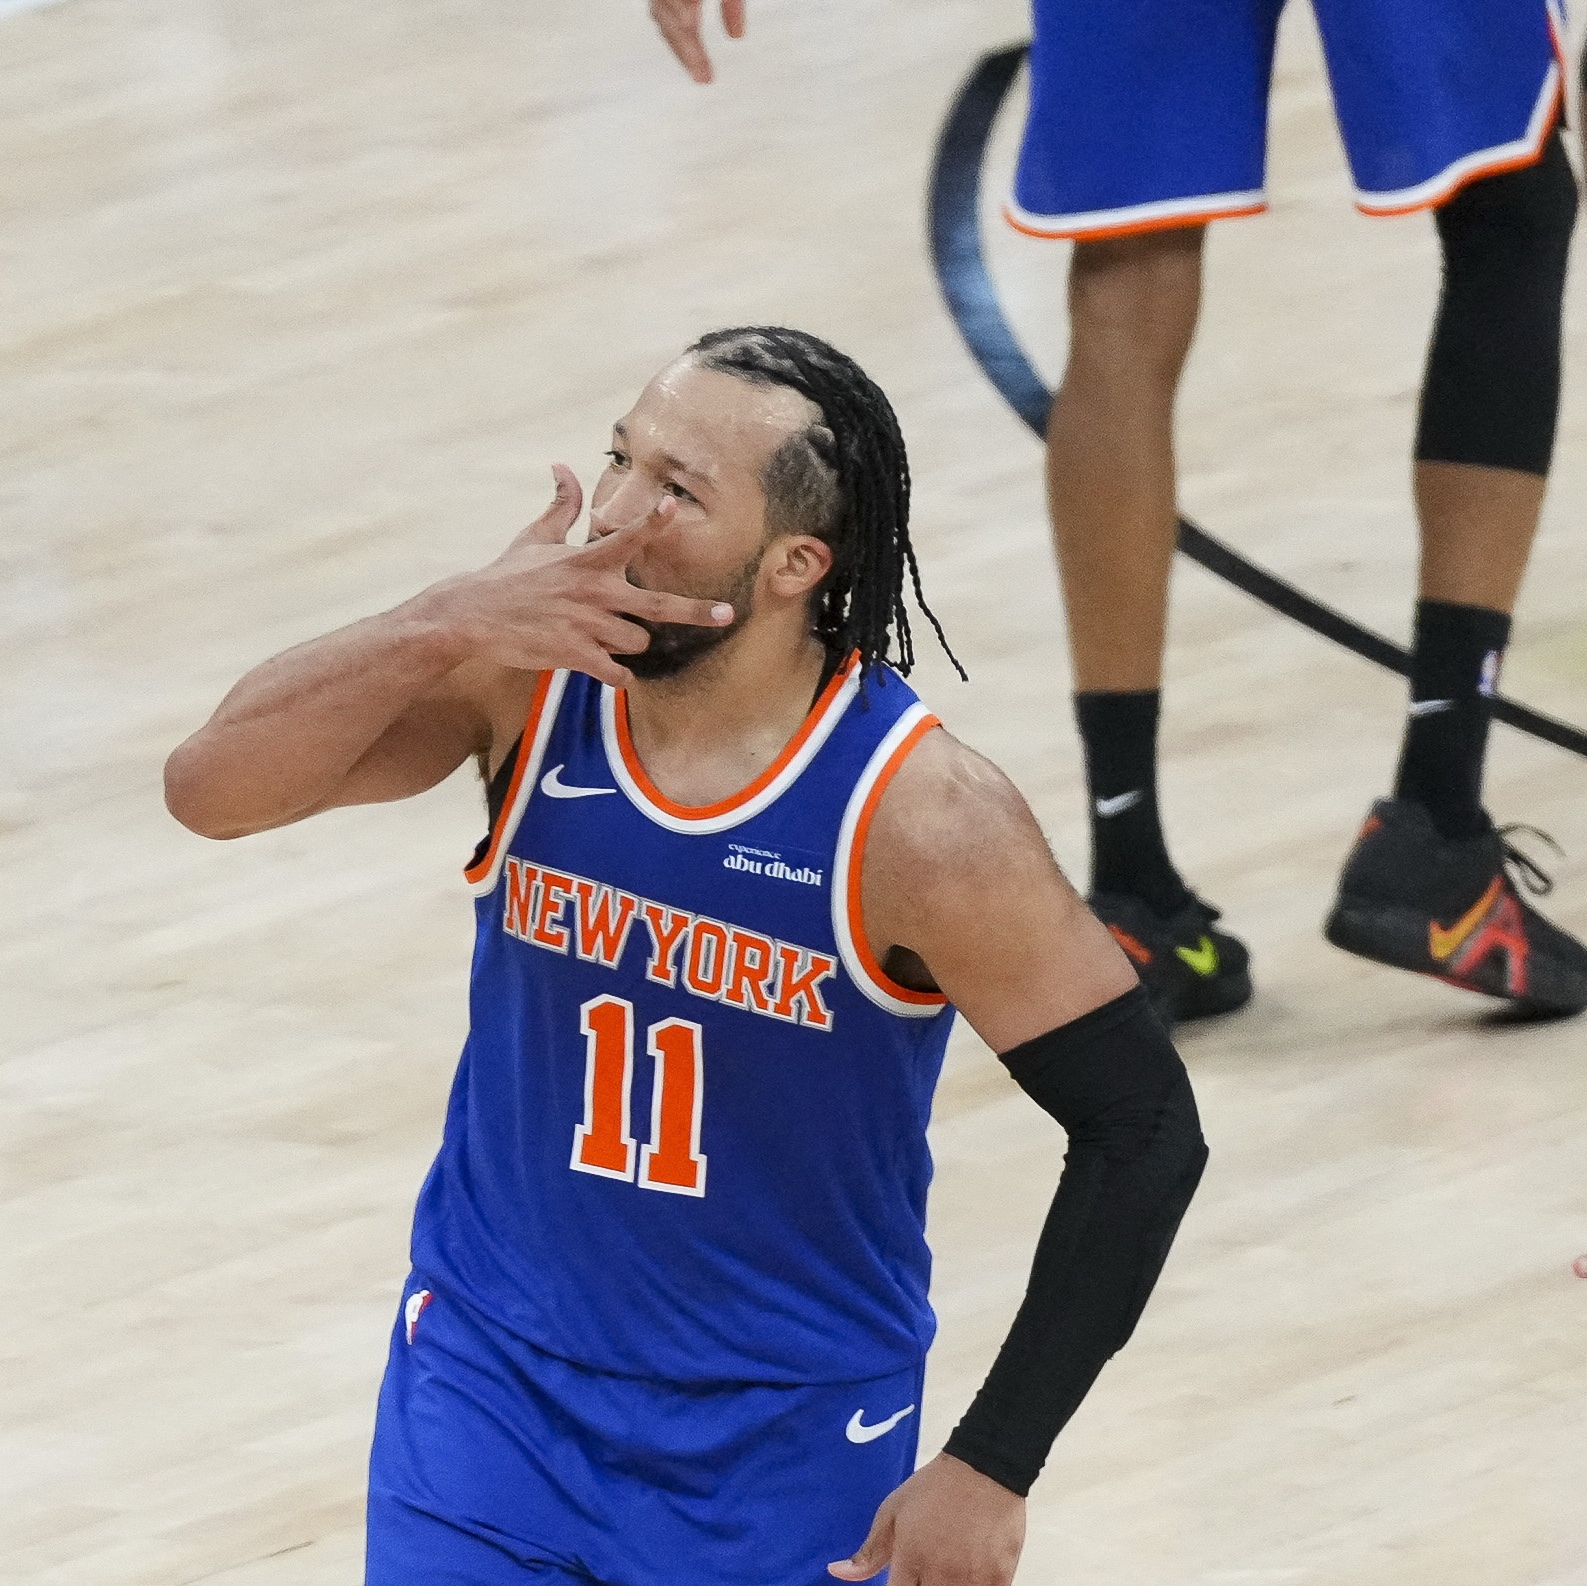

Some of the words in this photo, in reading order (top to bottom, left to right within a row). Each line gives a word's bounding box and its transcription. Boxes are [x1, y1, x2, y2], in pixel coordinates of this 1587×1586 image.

[503, 854, 643, 970] NEW
[642, 896, 839, 1033] YORK
[723, 854, 762, 875] abu
[764, 861, 824, 887] dhabi
[569, 993, 708, 1198] 11
